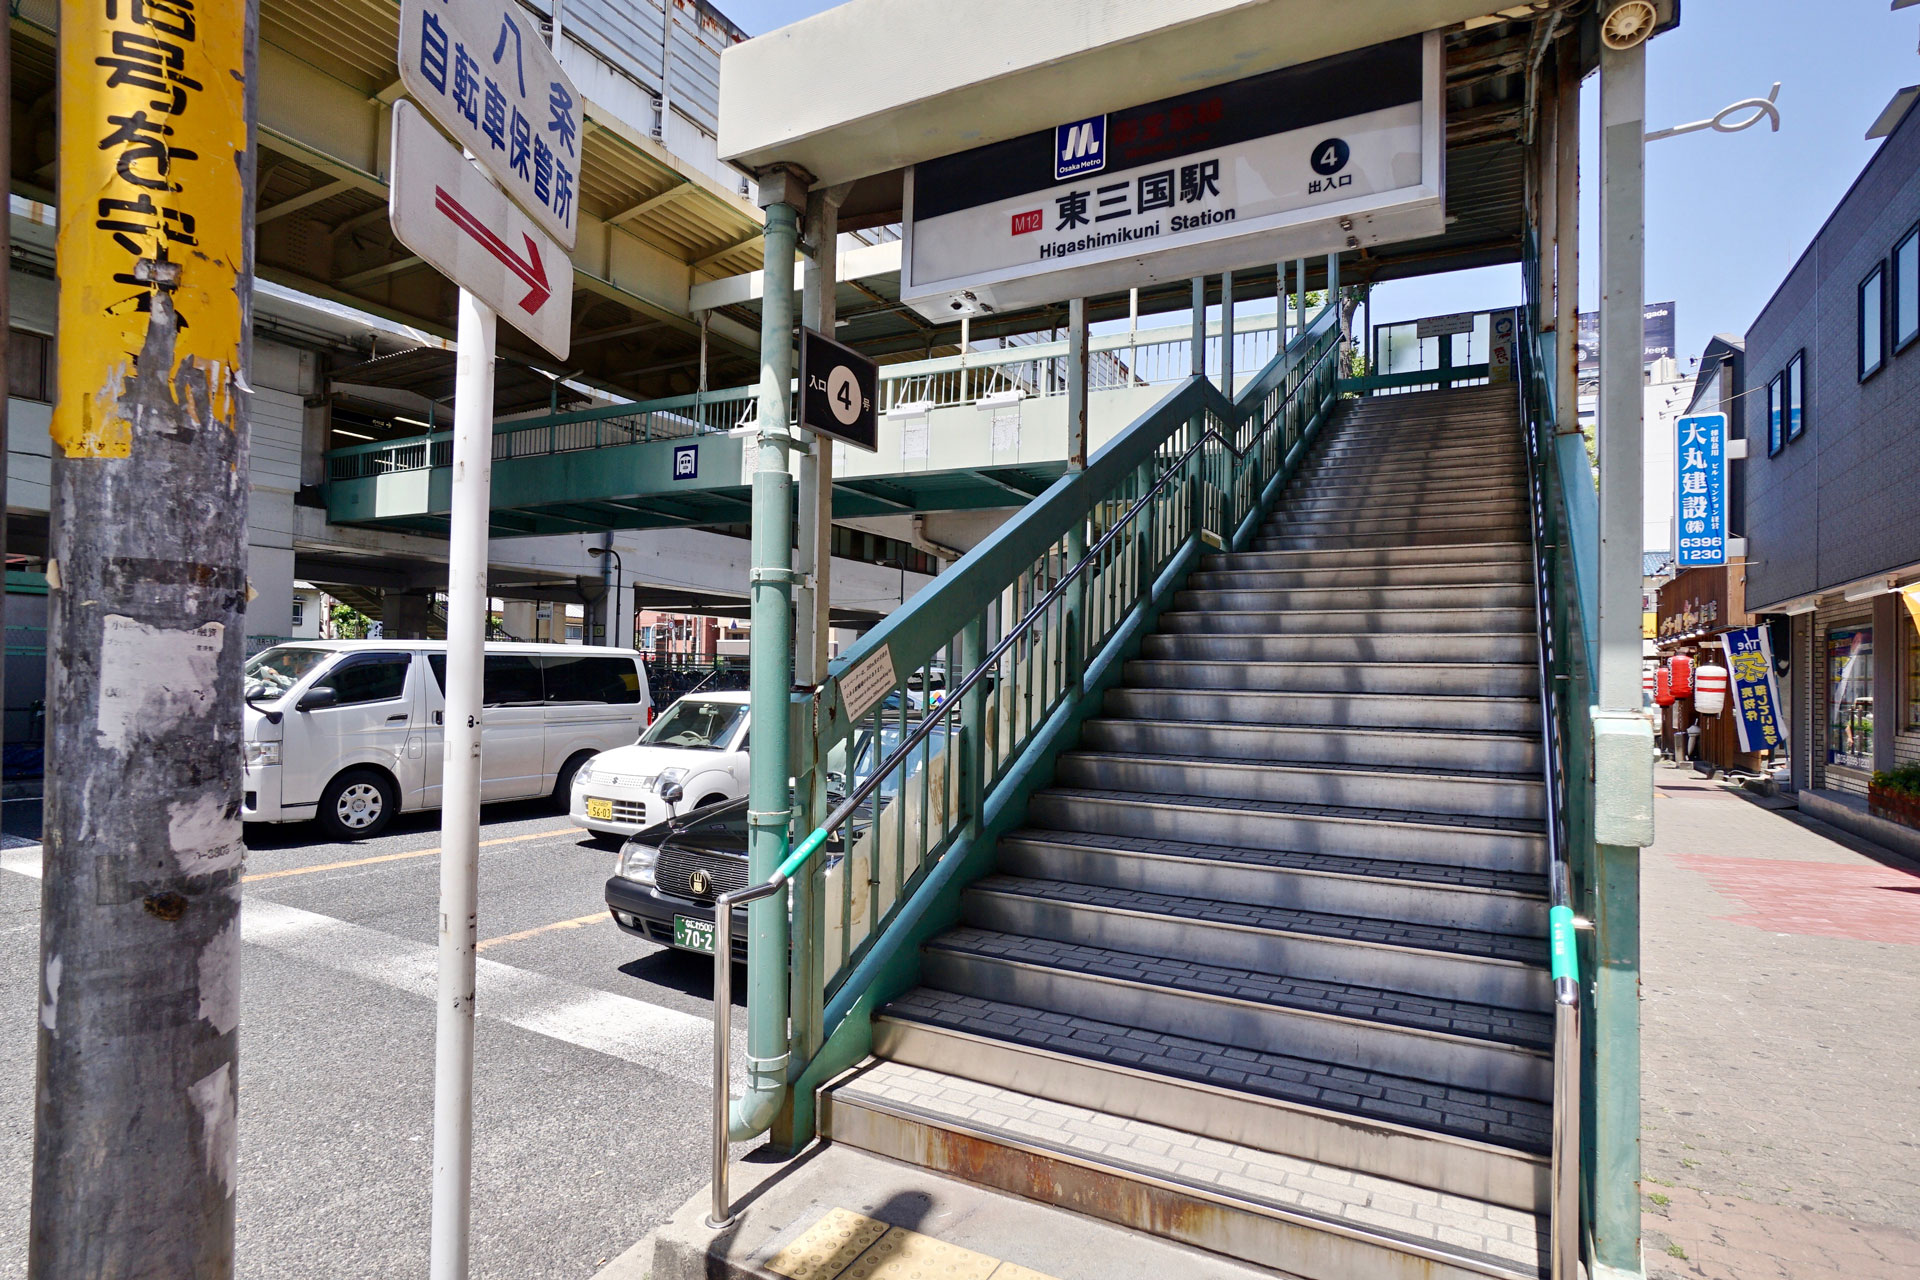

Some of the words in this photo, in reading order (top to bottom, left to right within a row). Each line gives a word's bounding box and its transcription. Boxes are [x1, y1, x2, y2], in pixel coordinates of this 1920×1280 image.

[420, 9, 573, 229] 自転車保管所
[1059, 163, 1080, 174] Osaka
[1081, 158, 1101, 169] Metro
[1320, 145, 1338, 167] 4
[1055, 158, 1220, 232] 東三国駅
[1308, 173, 1352, 195] 出入口
[1015, 213, 1040, 233] M12
[1040, 220, 1160, 259] Higashimikuni
[1170, 208, 1236, 232] Station
[809, 374, 827, 393] 入口
[837, 380, 852, 411] 4
[1680, 537, 1722, 548] 6396
[1682, 549, 1722, 560] 1230
